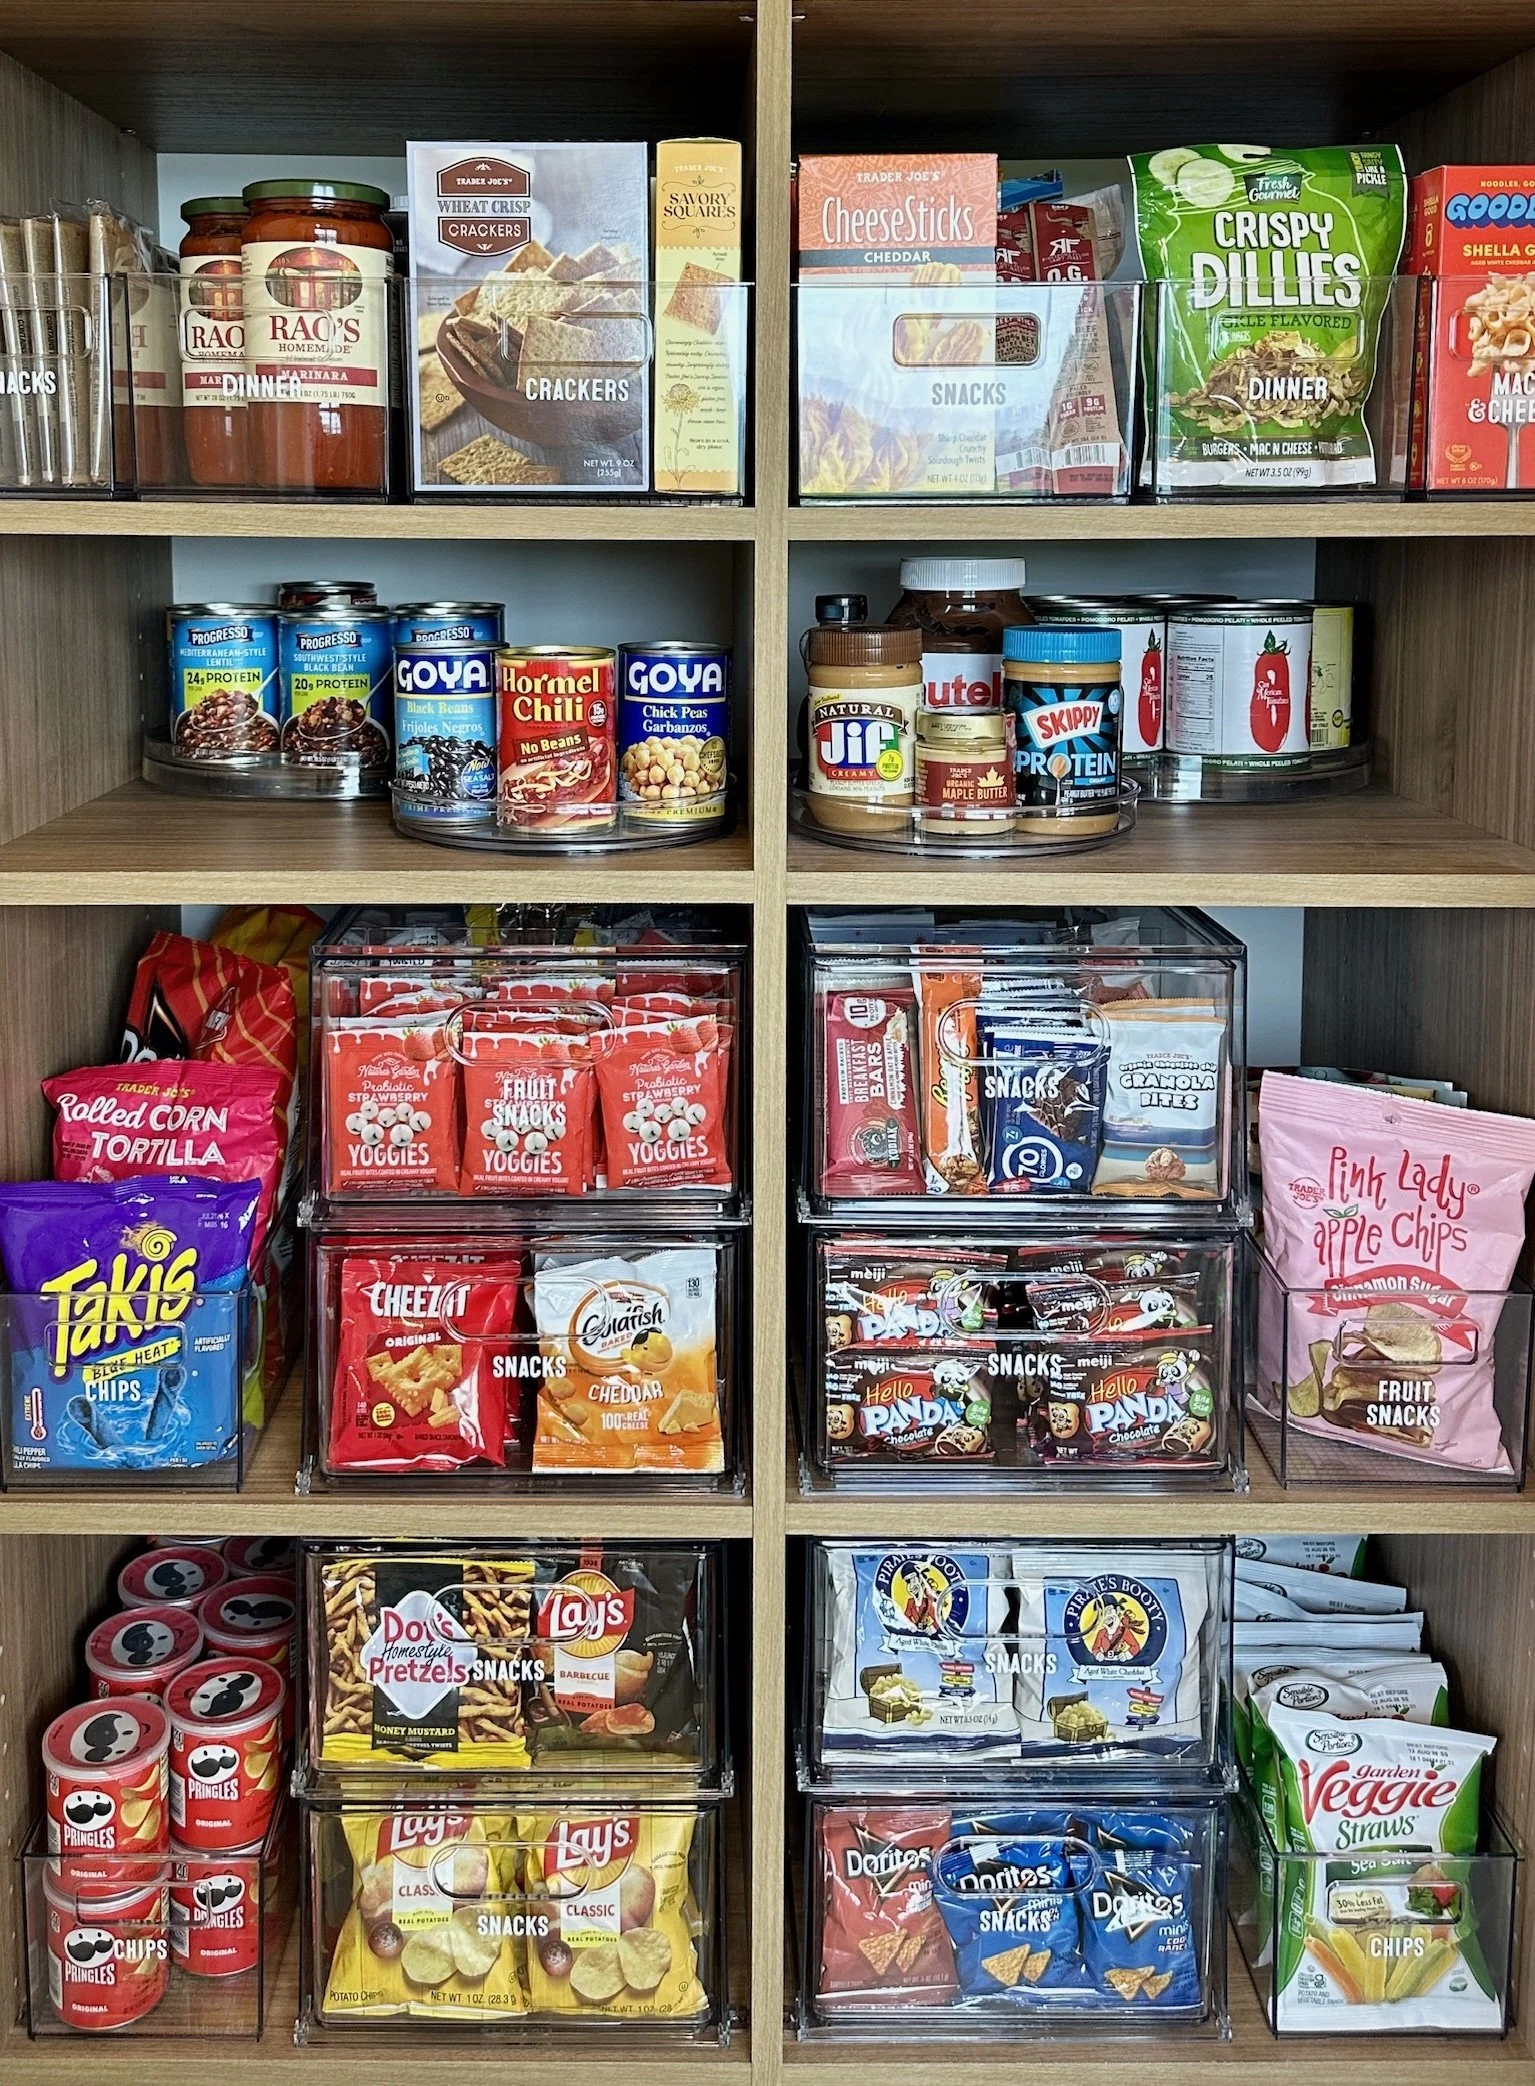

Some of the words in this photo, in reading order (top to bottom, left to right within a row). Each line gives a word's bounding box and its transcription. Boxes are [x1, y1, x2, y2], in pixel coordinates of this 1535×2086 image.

[456, 177, 485, 186] TRADER
[856, 171, 903, 183] TRADER
[906, 171, 941, 182] JOE'S
[1256, 176, 1293, 191] Fresh
[1356, 173, 1387, 186] PICKLE
[669, 191, 730, 206] SAVORY
[1248, 186, 1301, 202] Gourmet
[437, 200, 488, 214] WHEAT
[491, 200, 532, 214] CRISP
[663, 204, 737, 220] SQUARES
[821, 195, 975, 245] CheeseSticks
[448, 223, 522, 238] CRACKERS
[1214, 211, 1335, 250] CRISPY
[864, 250, 932, 264] CHEDDAR
[1462, 243, 1521, 257] SHELLA
[1191, 250, 1363, 309] DILLIES
[269, 314, 361, 343] RAO'S
[281, 369, 349, 382] MARINARA
[222, 373, 302, 398] DINNER
[525, 377, 630, 403] CRACKERS
[931, 382, 1007, 406] SNACKS
[1248, 377, 1329, 401] DINNER
[1061, 401, 1073, 410] 1G
[1086, 397, 1100, 406] 9G
[1191, 615, 1225, 624] POMODORO
[1225, 616, 1246, 624] PELATI
[1250, 616, 1272, 624] WHOLE
[191, 626, 249, 646] PROGRESSO
[299, 631, 357, 650] PROGRESSO
[179, 647, 267, 658] MEDITERRANEAN-STYLE
[293, 653, 367, 664] SOUTHWEST-STYLE
[206, 658, 234, 667] LENTIL
[303, 663, 331, 672] BLACK
[332, 663, 354, 672] BEAN
[206, 671, 261, 684] PROTEIN
[315, 677, 368, 690] PROTEIN
[397, 659, 489, 692] GOYA
[502, 666, 600, 695] Hormel
[628, 661, 722, 694] GOYA
[406, 701, 434, 715] Black
[436, 701, 474, 715] Beans
[513, 694, 584, 723] Chili
[642, 704, 679, 720] Chick
[681, 704, 708, 719] Peas
[818, 703, 895, 719] NATURAL
[402, 720, 439, 735] Frijoles
[441, 720, 484, 737] Negros
[642, 719, 708, 735] Garbanzos
[1036, 706, 1101, 741] SKIPPY
[520, 741, 538, 756] No
[540, 732, 582, 751] Beans
[820, 721, 895, 765] Jif
[1221, 758, 1244, 768] PELATI
[1248, 759, 1271, 768] WHOLE
[831, 769, 874, 778] CREAMY
[942, 787, 974, 800] MAPLE
[976, 786, 1008, 800] BUTTER
[945, 779, 975, 788] ORGANIC
[666, 805, 712, 815] PREMIUM
[852, 1038, 868, 1104] BREAKFAST
[868, 1041, 886, 1098] BARS
[1119, 1060, 1154, 1072] organic
[1154, 1060, 1199, 1070] chocolate
[1200, 1062, 1217, 1073] chip
[361, 1080, 415, 1093] Probiotic
[503, 1078, 557, 1101] FRUIT
[635, 1075, 688, 1090] Probiotic
[984, 1075, 1060, 1099] SNACKS
[1119, 1073, 1216, 1091] GRANOLA
[347, 1092, 429, 1103] STRAWBERRY
[622, 1083, 702, 1102] STRAWBERRY
[1140, 1092, 1199, 1111] BITES
[56, 1092, 149, 1128] Rolled
[149, 1104, 229, 1133] CORN
[492, 1104, 567, 1127] SNACKS
[91, 1131, 226, 1167] TORTILLA
[627, 1135, 709, 1166] YOGGIES
[886, 1125, 900, 1162] KODIAK
[347, 1142, 430, 1168] YOGGIES
[481, 1149, 563, 1175] YOGGIES
[1018, 1148, 1040, 1176] 70
[1039, 1148, 1048, 1178] CALORIES
[1288, 1181, 1327, 1197] TRADER
[1327, 1145, 1387, 1212] Pink
[1398, 1149, 1468, 1220] Lady
[1313, 1212, 1382, 1278] apple
[1390, 1205, 1469, 1273] Chips
[850, 1267, 886, 1283] meiji
[40, 1247, 198, 1378] Takis
[194, 1333, 231, 1346] ARTIFICIALLY
[194, 1343, 225, 1353] FLAVORED
[491, 1354, 567, 1380] SNACKS
[987, 1353, 1062, 1377] SNACKS
[85, 1379, 141, 1402] CHIPS
[588, 1378, 665, 1404] CHEDDAR
[866, 1380, 914, 1406] Hello
[1091, 1376, 1138, 1403] Hello
[1377, 1379, 1434, 1404] FRUIT
[1193, 1402, 1210, 1412] Size
[1194, 1394, 1211, 1405] Bite
[860, 1395, 962, 1437] PANDA
[1086, 1391, 1185, 1434] PANDA
[1365, 1403, 1442, 1428] SNACKS
[621, 1421, 649, 1430] CHEESE
[23, 1447, 47, 1456] PEPPER
[1066, 1575, 1118, 1621] PIRATE'S
[1121, 1578, 1165, 1622] BOOTY
[550, 1590, 626, 1641] Lay's
[384, 1610, 454, 1643] Dot's
[381, 1640, 454, 1667] Homestyle
[369, 1655, 468, 1685] Pretzels
[471, 1658, 546, 1682] SNACKS
[559, 1670, 611, 1681] BARBECUE
[1084, 1667, 1100, 1676] Aged
[1100, 1667, 1118, 1675] White
[1119, 1667, 1146, 1676] Cheddar
[558, 1699, 575, 1707] REAL
[577, 1701, 613, 1710] POTATOES
[373, 1723, 407, 1736] HONEY
[407, 1726, 456, 1737] MUSTARD
[1320, 1740, 1355, 1751] Portions
[1352, 1764, 1421, 1779] garden
[188, 1777, 239, 1801] PRINGLES
[1298, 1758, 1458, 1825] Veggie
[195, 1818, 233, 1828] ORIGINAL
[1335, 1815, 1415, 1850] Straws
[63, 1825, 116, 1850] PRINGLES
[556, 1817, 632, 1868] Lay's
[846, 1846, 932, 1877] Doritos
[70, 1868, 108, 1879] ORIGINAL
[566, 1903, 615, 1917] CLASSIC
[1336, 1899, 1355, 1909] 30%
[1356, 1897, 1372, 1908] Less
[1373, 1896, 1384, 1905] Fat
[398, 1917, 415, 1925] REAL
[416, 1916, 450, 1925] POTATOES
[567, 1935, 584, 1943] REAL
[585, 1935, 619, 1943] POTATOES
[1370, 1936, 1425, 1958] CHIPS
[113, 1939, 168, 1961] CHIPS
[200, 1946, 238, 1957] ORIGINAL
[65, 1962, 116, 1985] PRINGLES
[71, 2003, 109, 2013] ORIGINAL
